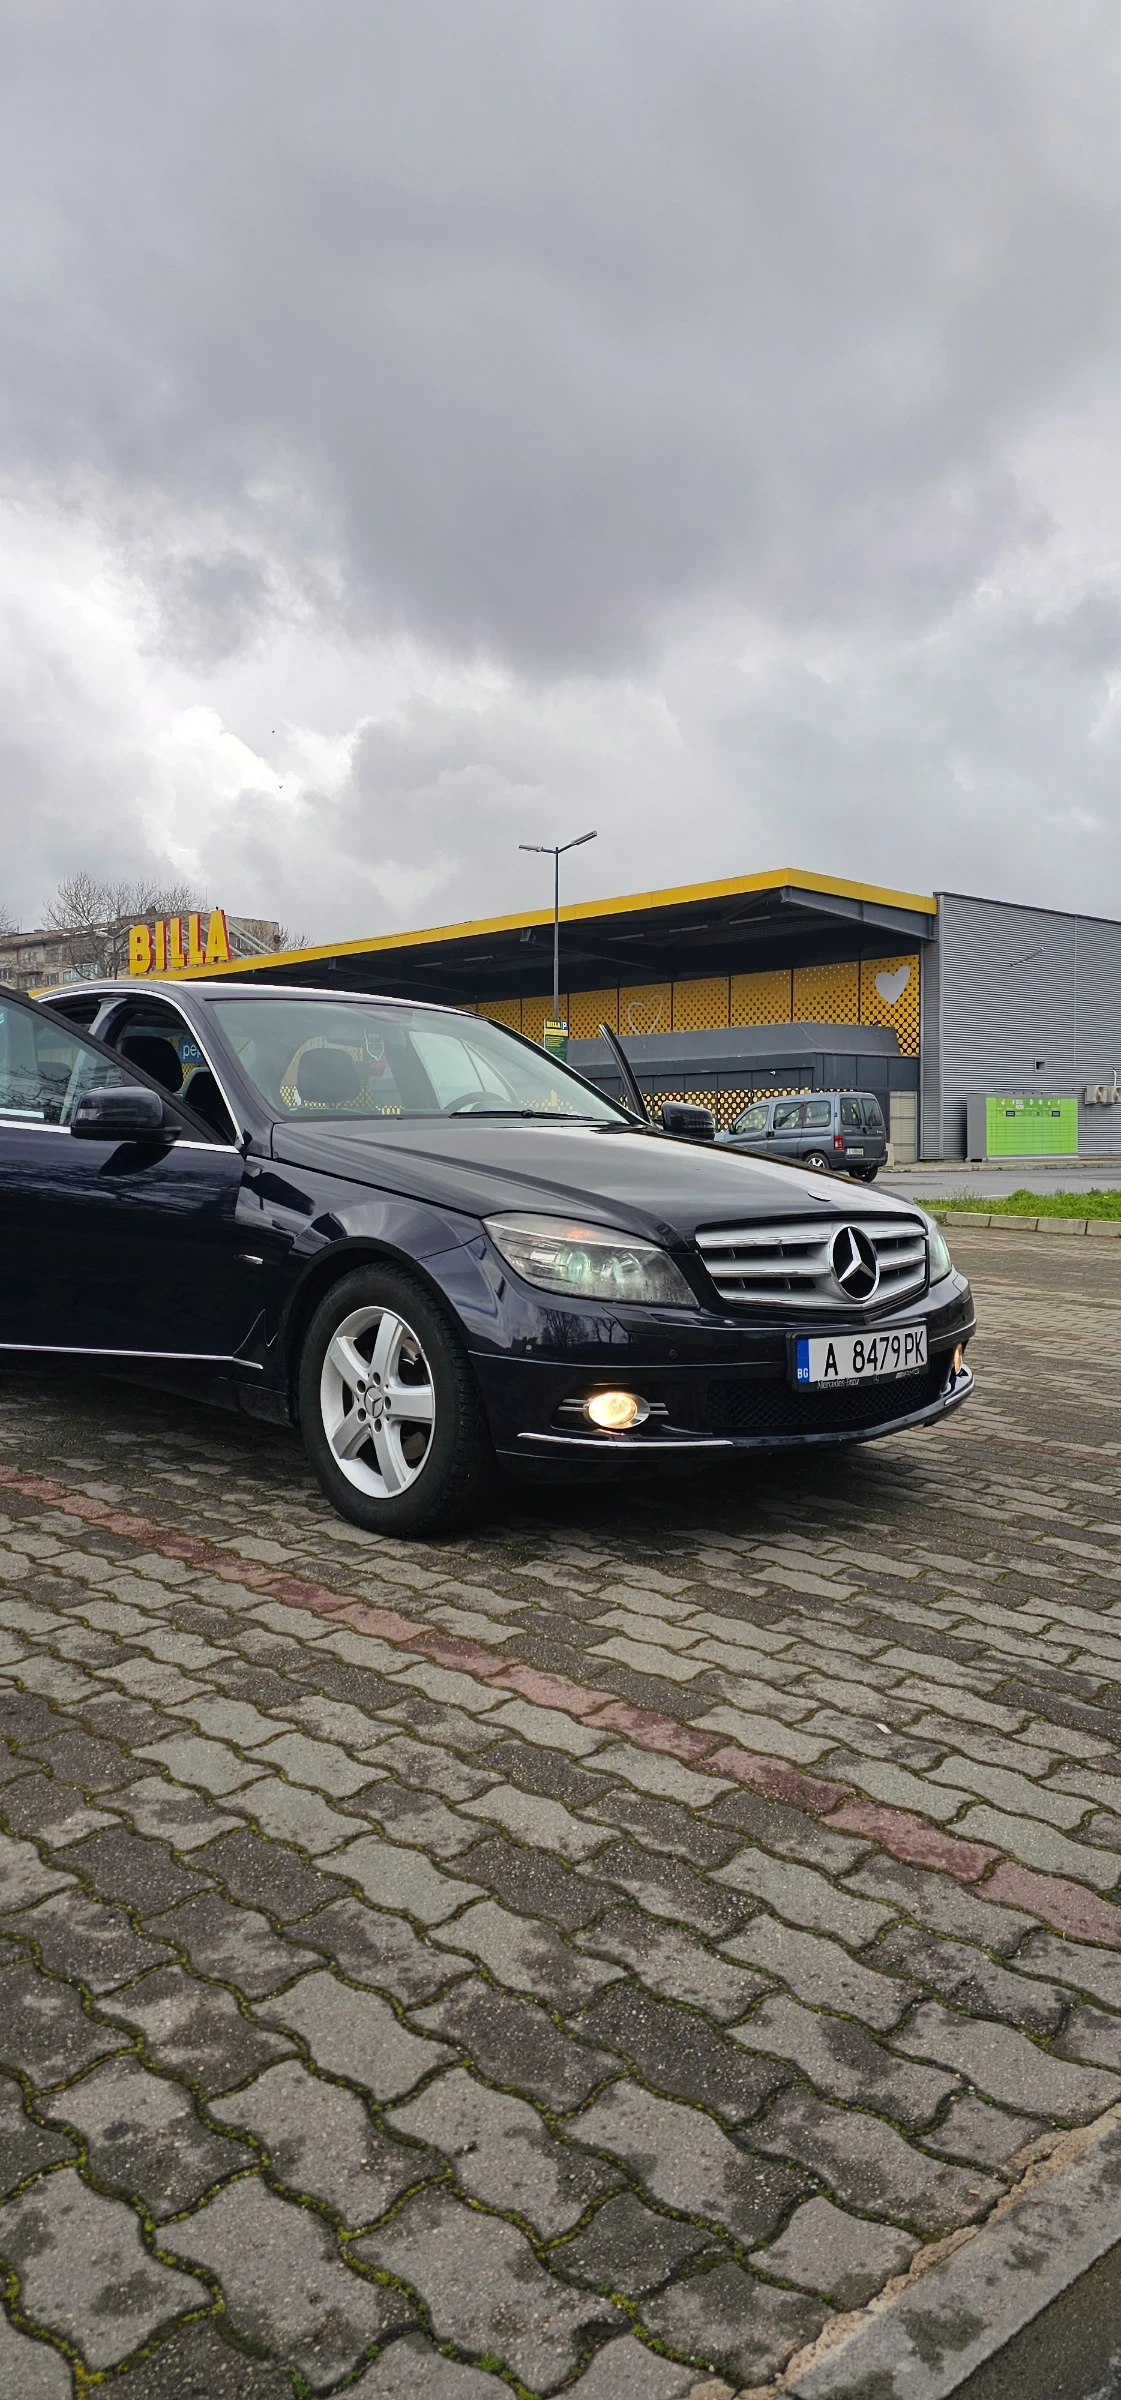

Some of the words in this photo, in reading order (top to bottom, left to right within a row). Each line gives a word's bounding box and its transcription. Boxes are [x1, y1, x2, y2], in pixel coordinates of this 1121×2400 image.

[129, 910, 230, 975] BILLA
[797, 1368, 809, 1379] BG
[824, 1342, 839, 1377] A
[852, 1335, 901, 1374] 8479
